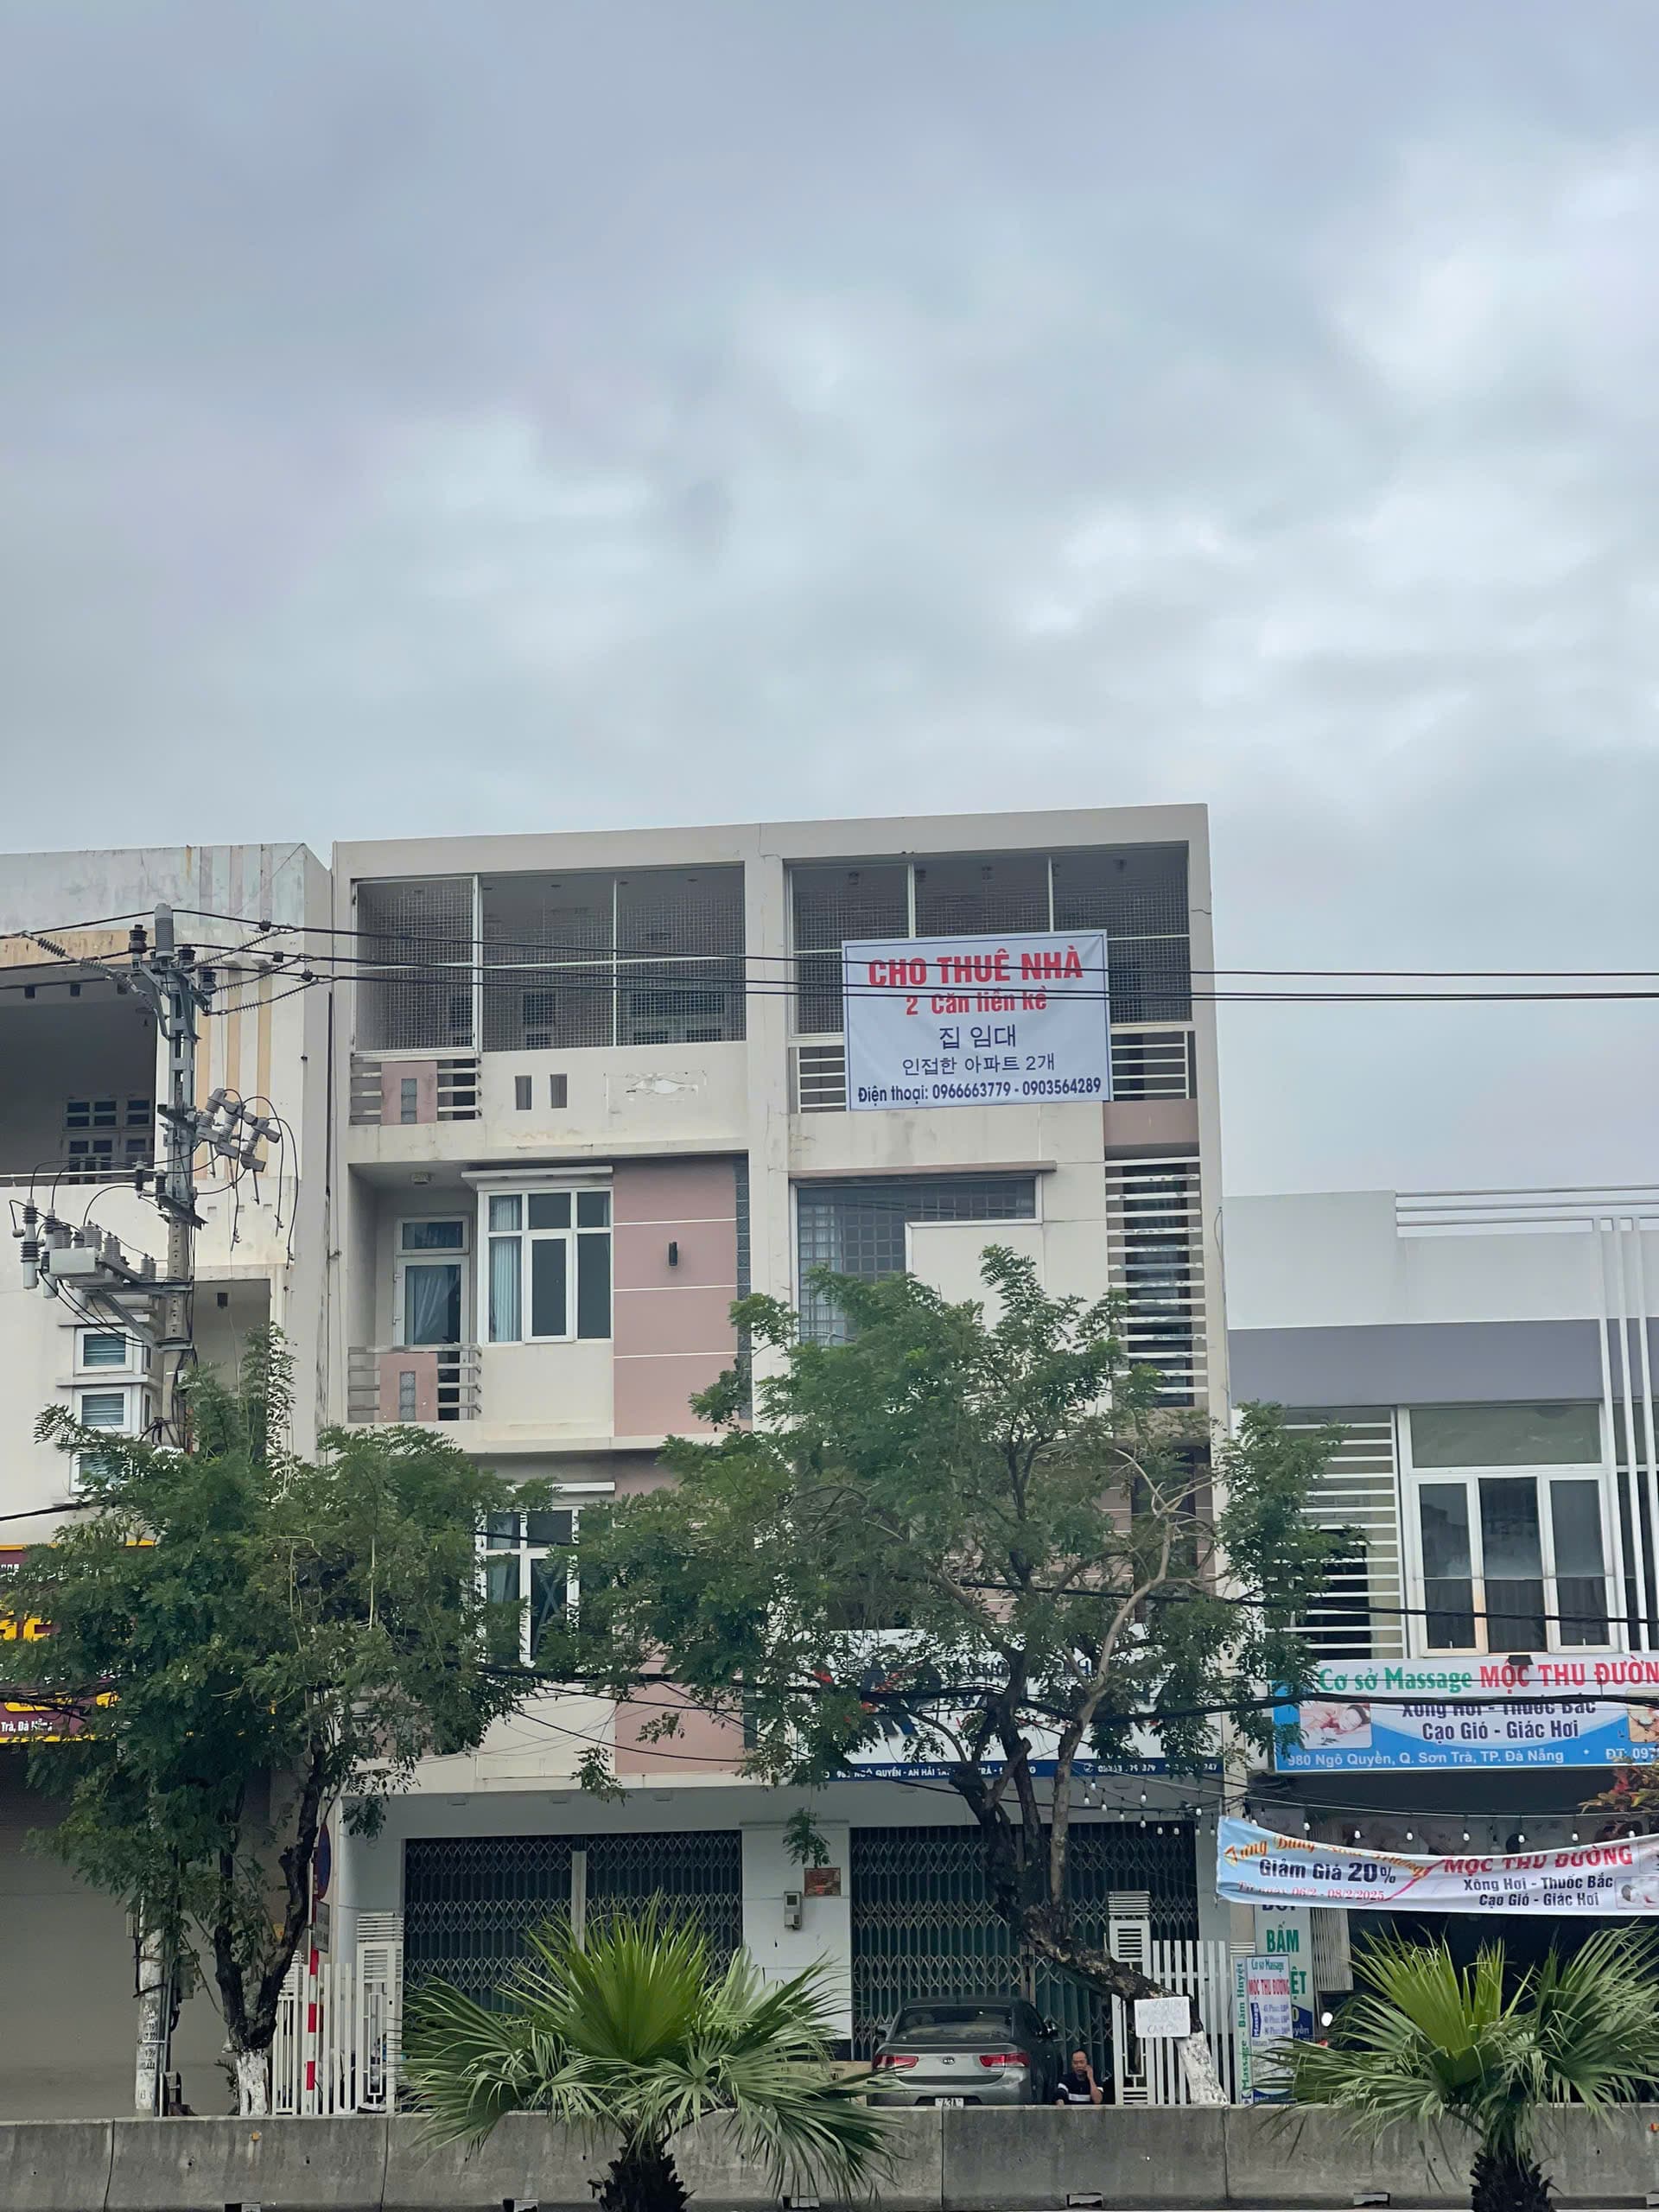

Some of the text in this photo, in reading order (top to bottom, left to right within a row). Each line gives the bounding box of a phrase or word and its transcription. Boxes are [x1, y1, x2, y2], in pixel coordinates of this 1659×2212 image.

[868, 945, 1084, 987] CHO THUÊ NHÀ
[906, 995, 918, 1016] 2
[931, 992, 970, 1014] Căn
[939, 1024, 1016, 1050] 집 임대
[902, 1052, 1055, 1077] 인접한 아파트 2개
[858, 1085, 887, 1107] Điện
[891, 1084, 929, 1105] thoại:
[932, 1081, 1011, 1100] 0966663779
[1022, 1077, 1102, 1096] 0903564289
[1319, 1668, 1348, 1691] Cơ
[1355, 1667, 1379, 1691] sở
[1384, 1666, 1473, 1694] Massage
[1538, 1663, 1586, 1687] THU
[18, 1720, 29, 1731] Đà
[1422, 1722, 1454, 1744] Cạo
[1460, 1721, 1488, 1740] Gió
[1506, 1720, 1545, 1740] Giác
[1550, 1719, 1579, 1738] Hơi
[1288, 1755, 1312, 1766] 980
[1315, 1753, 1342, 1768] Ngô
[1347, 1751, 1395, 1766] Quyền,
[1399, 1752, 1414, 1764] Q.
[1418, 1752, 1447, 1764] Sơn
[1451, 1751, 1477, 1764] Trà,
[1480, 1751, 1501, 1763] TP.
[1505, 1749, 1523, 1762] Đà
[1528, 1748, 1564, 1764] Nẵng
[1502, 1854, 1547, 1871] THU
[1555, 1845, 1633, 1868] ĐƯỜNG
[1260, 1858, 1396, 1884] Giảm Giá 20%
[1464, 1878, 1499, 1891] Xông
[1504, 1878, 1527, 1891] Hơi
[1541, 1873, 1582, 1890] Thuốc
[1587, 1872, 1613, 1888] Bắc
[1327, 1888, 1385, 1900] 08/2/2025
[1479, 1893, 1503, 1909] Cạo
[1508, 1892, 1529, 1906] Gió
[1543, 1892, 1573, 1906] Giác
[1577, 1892, 1599, 1906] Hơi
[1266, 1920, 1300, 1953] BẤM
